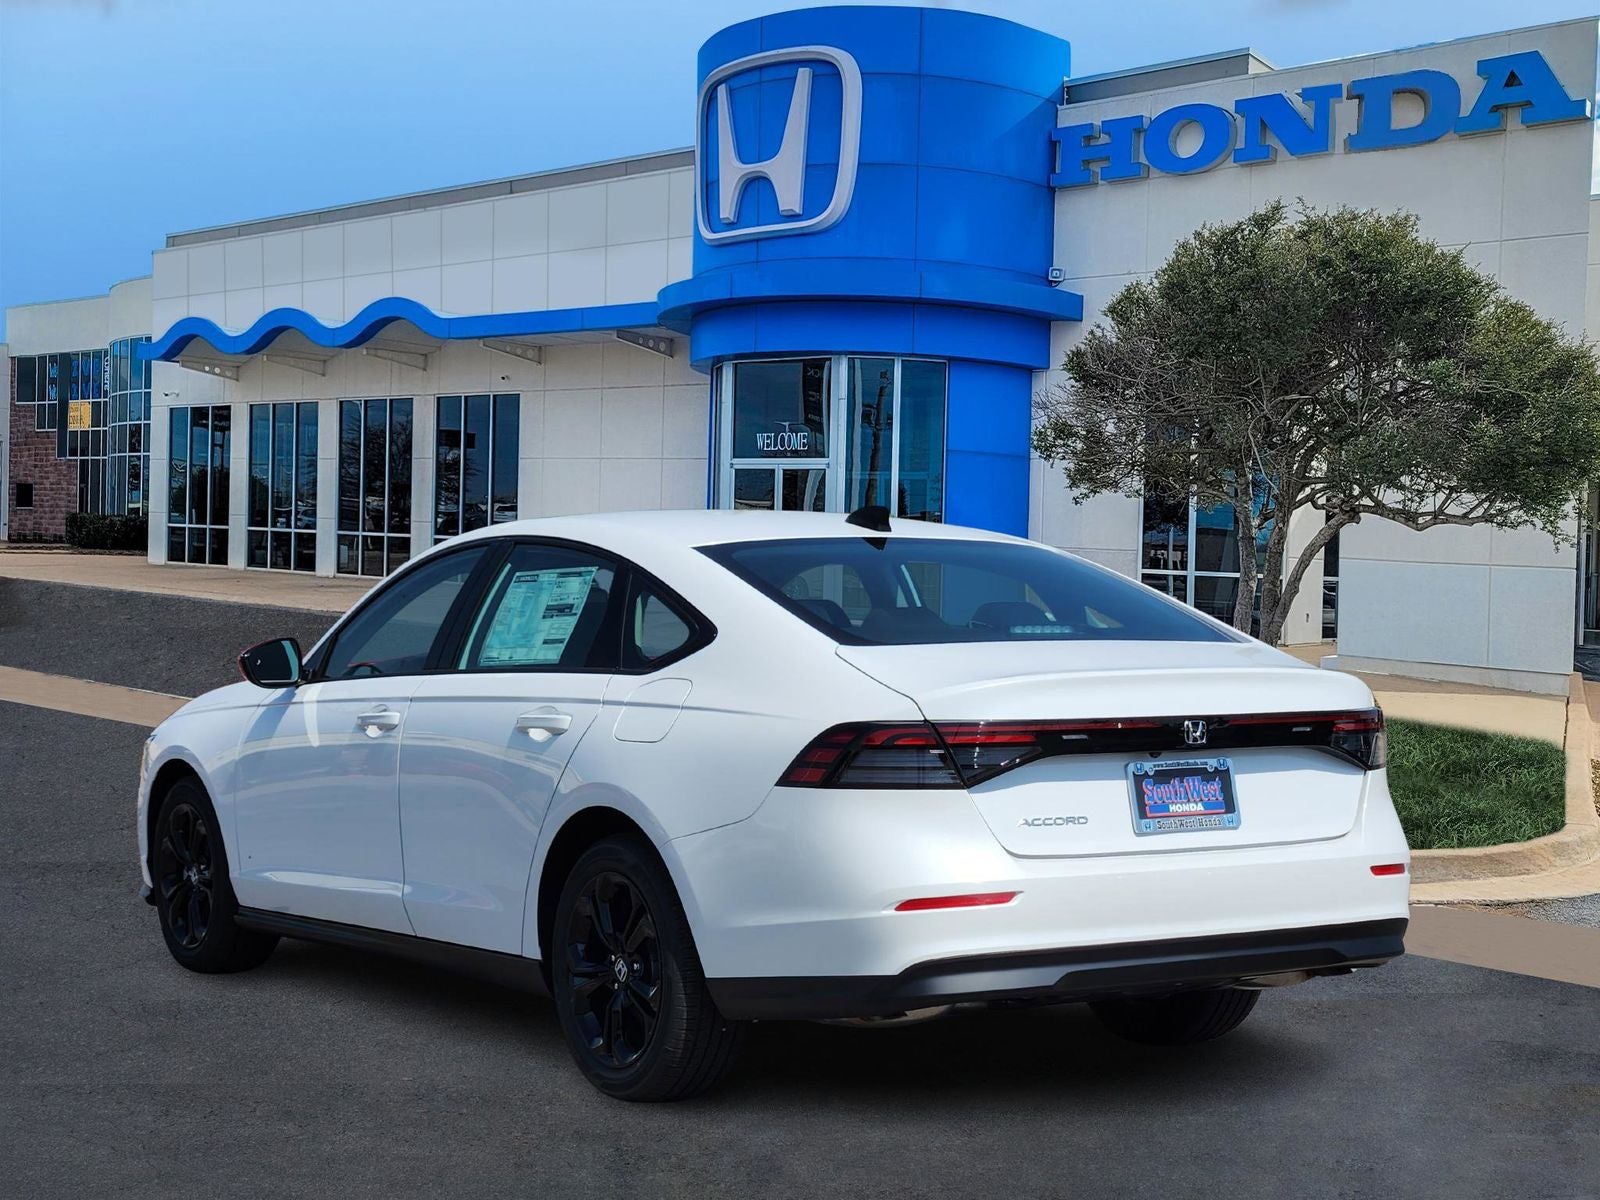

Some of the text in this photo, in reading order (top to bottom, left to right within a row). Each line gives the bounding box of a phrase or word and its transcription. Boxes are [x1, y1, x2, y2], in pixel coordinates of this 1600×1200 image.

[1050, 50, 1591, 188] HONDA
[756, 432, 809, 451] WELCOME
[1169, 803, 1205, 813] HONDA
[1017, 815, 1089, 828] ACCORD
